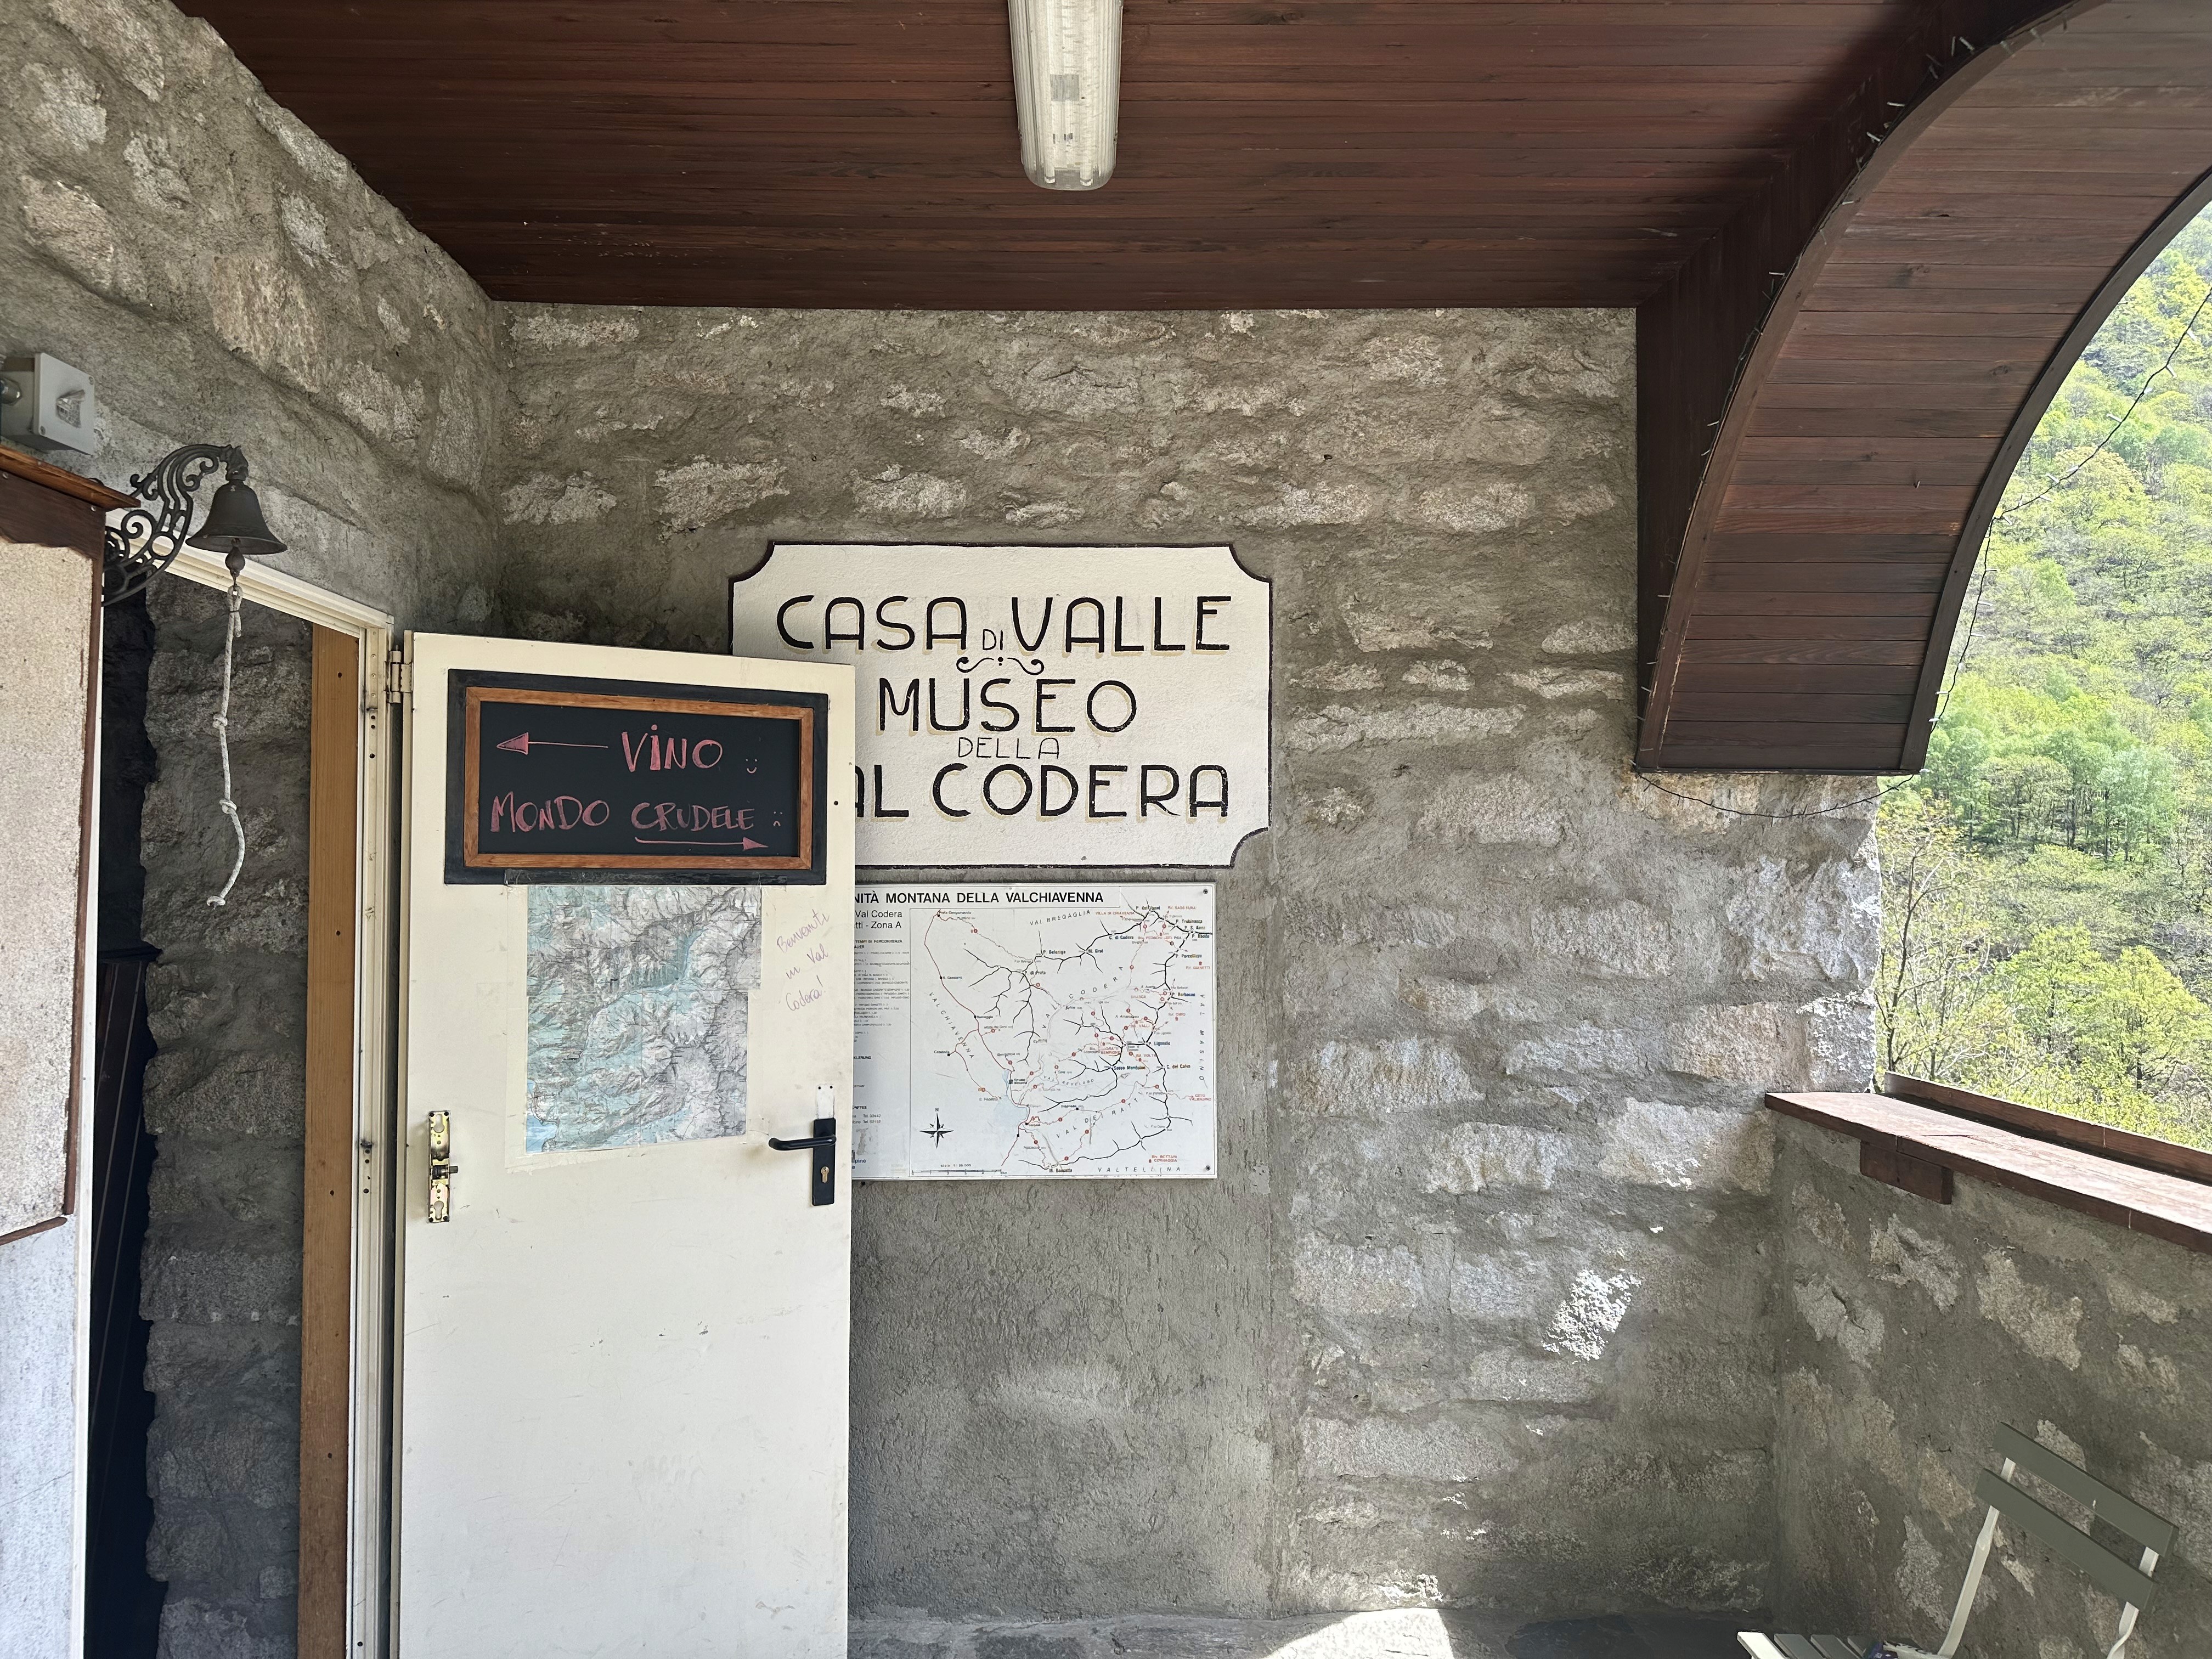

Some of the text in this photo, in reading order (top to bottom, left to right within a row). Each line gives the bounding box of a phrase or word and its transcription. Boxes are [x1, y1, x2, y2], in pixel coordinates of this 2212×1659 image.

[776, 595, 1232, 654] CASA DI VALLE
[879, 678, 1137, 732] MUSEO
[958, 737, 1060, 760] DELLA
[933, 763, 1229, 818] CODERA
[490, 791, 755, 833] MONDO CRUDELE
[886, 893, 950, 904] MONTANA
[957, 892, 1002, 903] DELLA
[1006, 891, 1104, 903] VALCHIAVENNA
[1047, 910, 1091, 923] BREGAGLIA
[806, 943, 829, 964] Val
[786, 974, 826, 1011] Codera!
[1069, 966, 1124, 999] CODERA
[929, 992, 974, 1059] VALCHIAVENNA
[1057, 1126, 1077, 1138] VAL
